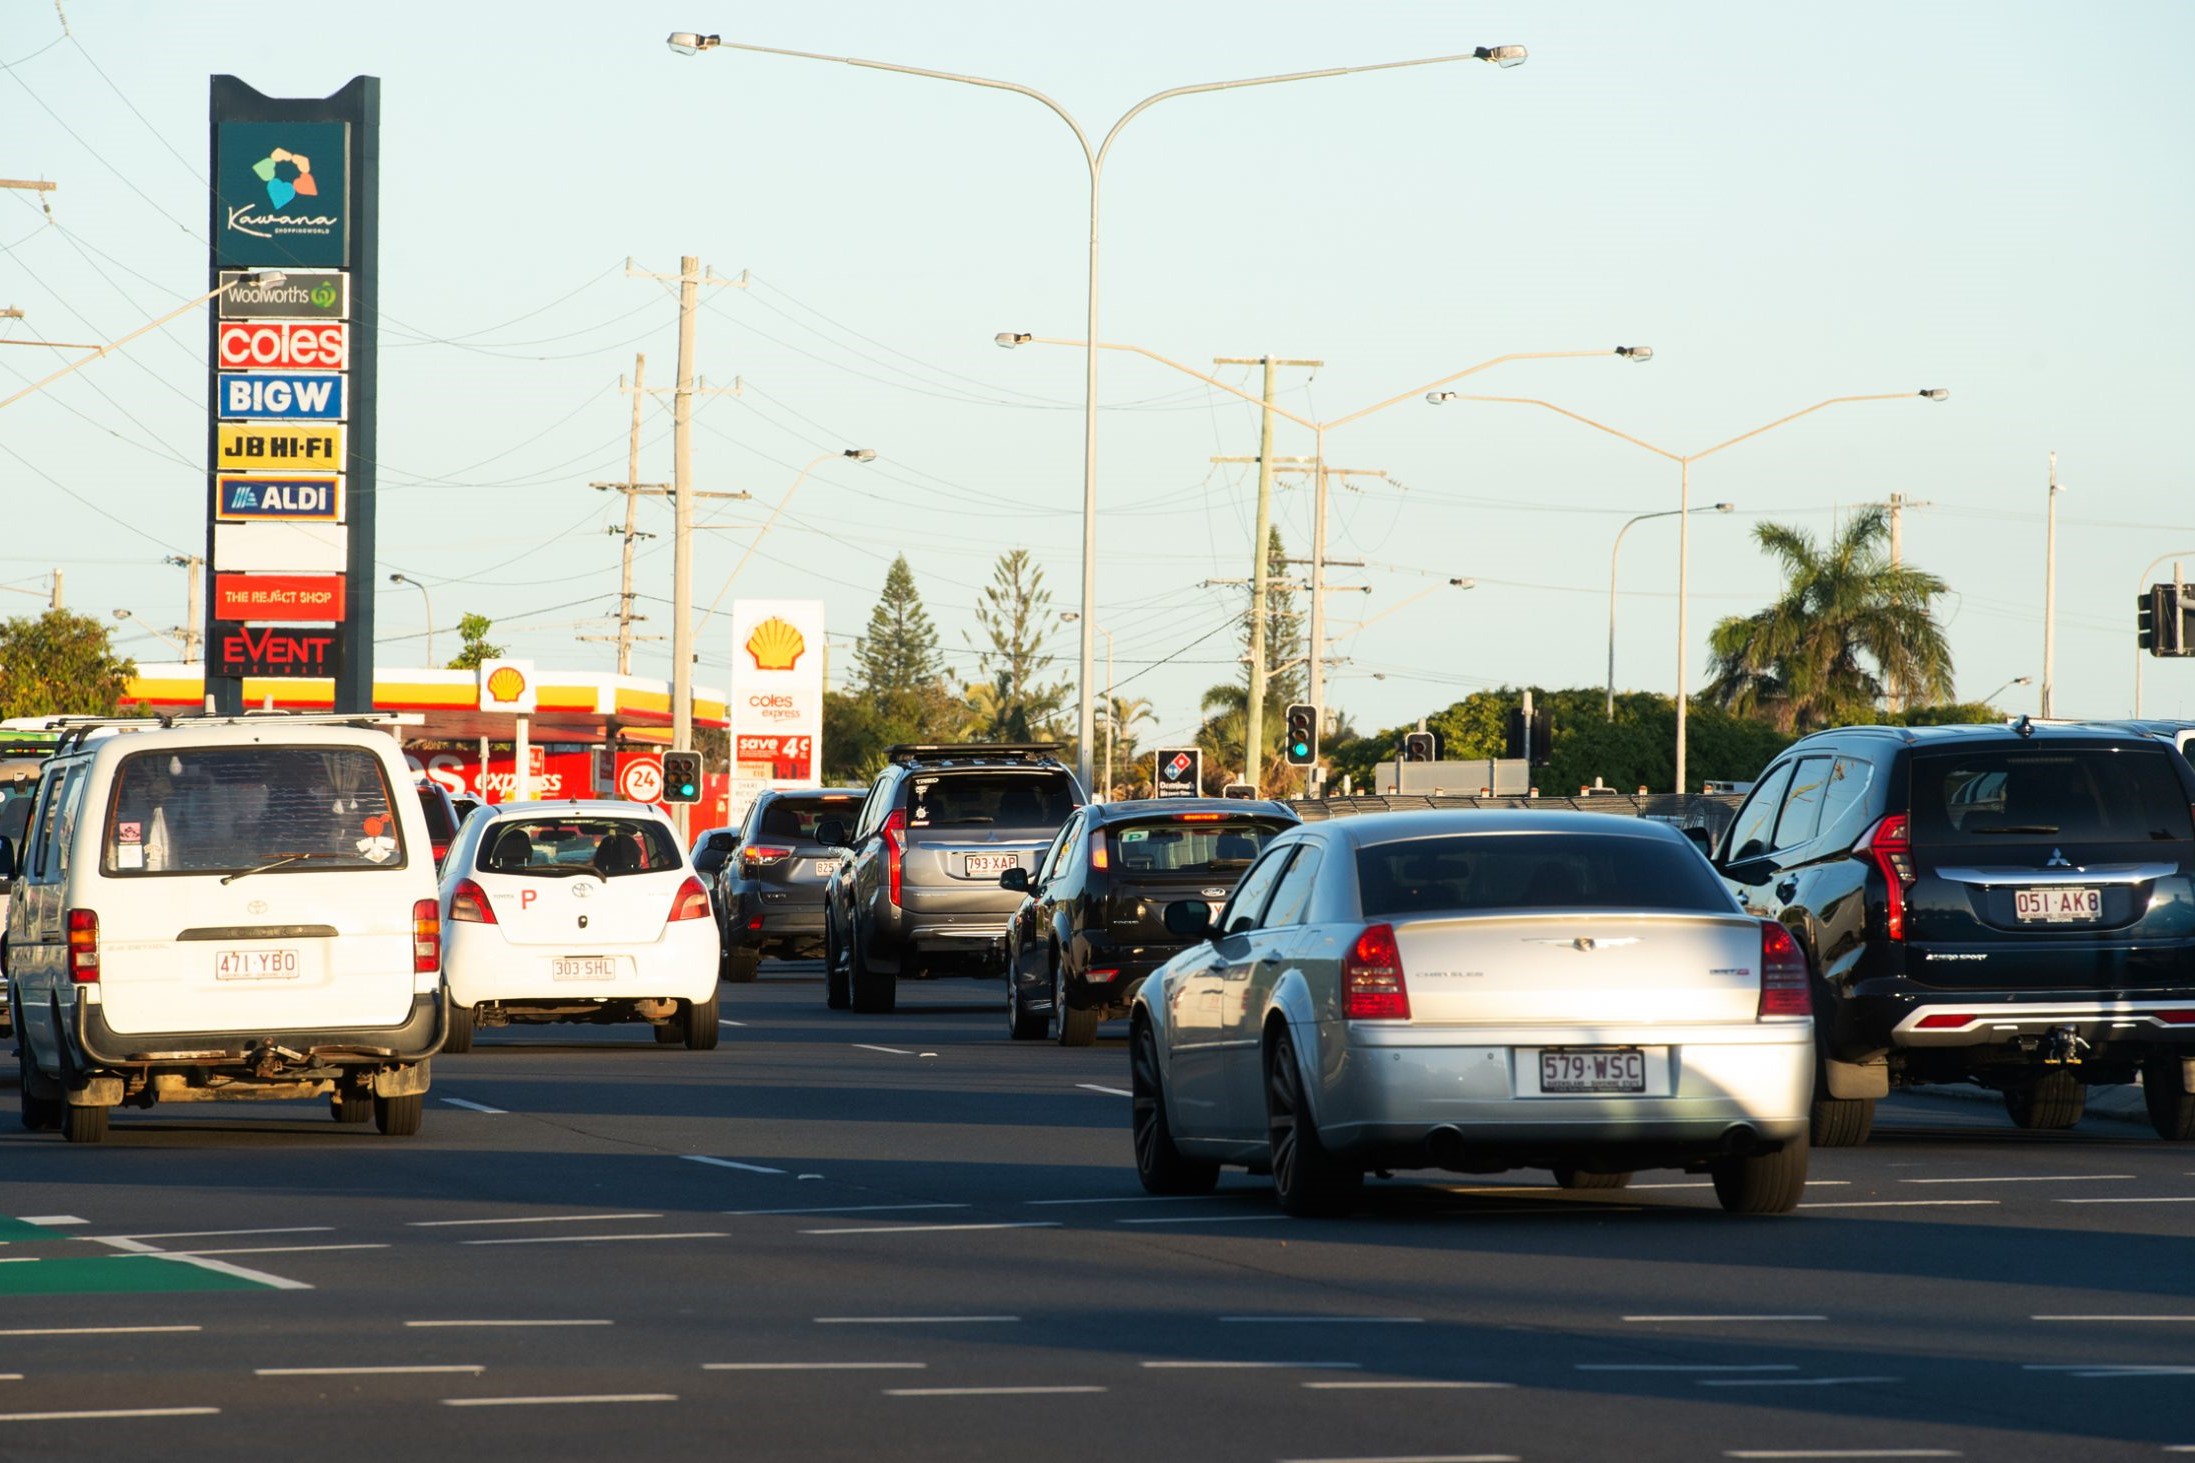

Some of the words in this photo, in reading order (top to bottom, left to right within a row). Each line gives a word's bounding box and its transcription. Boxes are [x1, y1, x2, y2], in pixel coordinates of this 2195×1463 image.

[227, 203, 338, 238] Kawana
[227, 285, 310, 303] Woolworths
[220, 324, 343, 365] coles
[224, 436, 265, 458] JB
[261, 486, 327, 511] ALDI
[225, 591, 249, 603] THE
[252, 589, 297, 603] REJECT
[300, 592, 332, 604] SHOP
[223, 626, 332, 663] EVENT
[748, 693, 794, 708] coles
[761, 708, 801, 719] express
[739, 738, 779, 750] save
[474, 772, 562, 798] expss
[633, 771, 656, 787] 24
[1128, 833, 1142, 841] P
[521, 889, 537, 910] P
